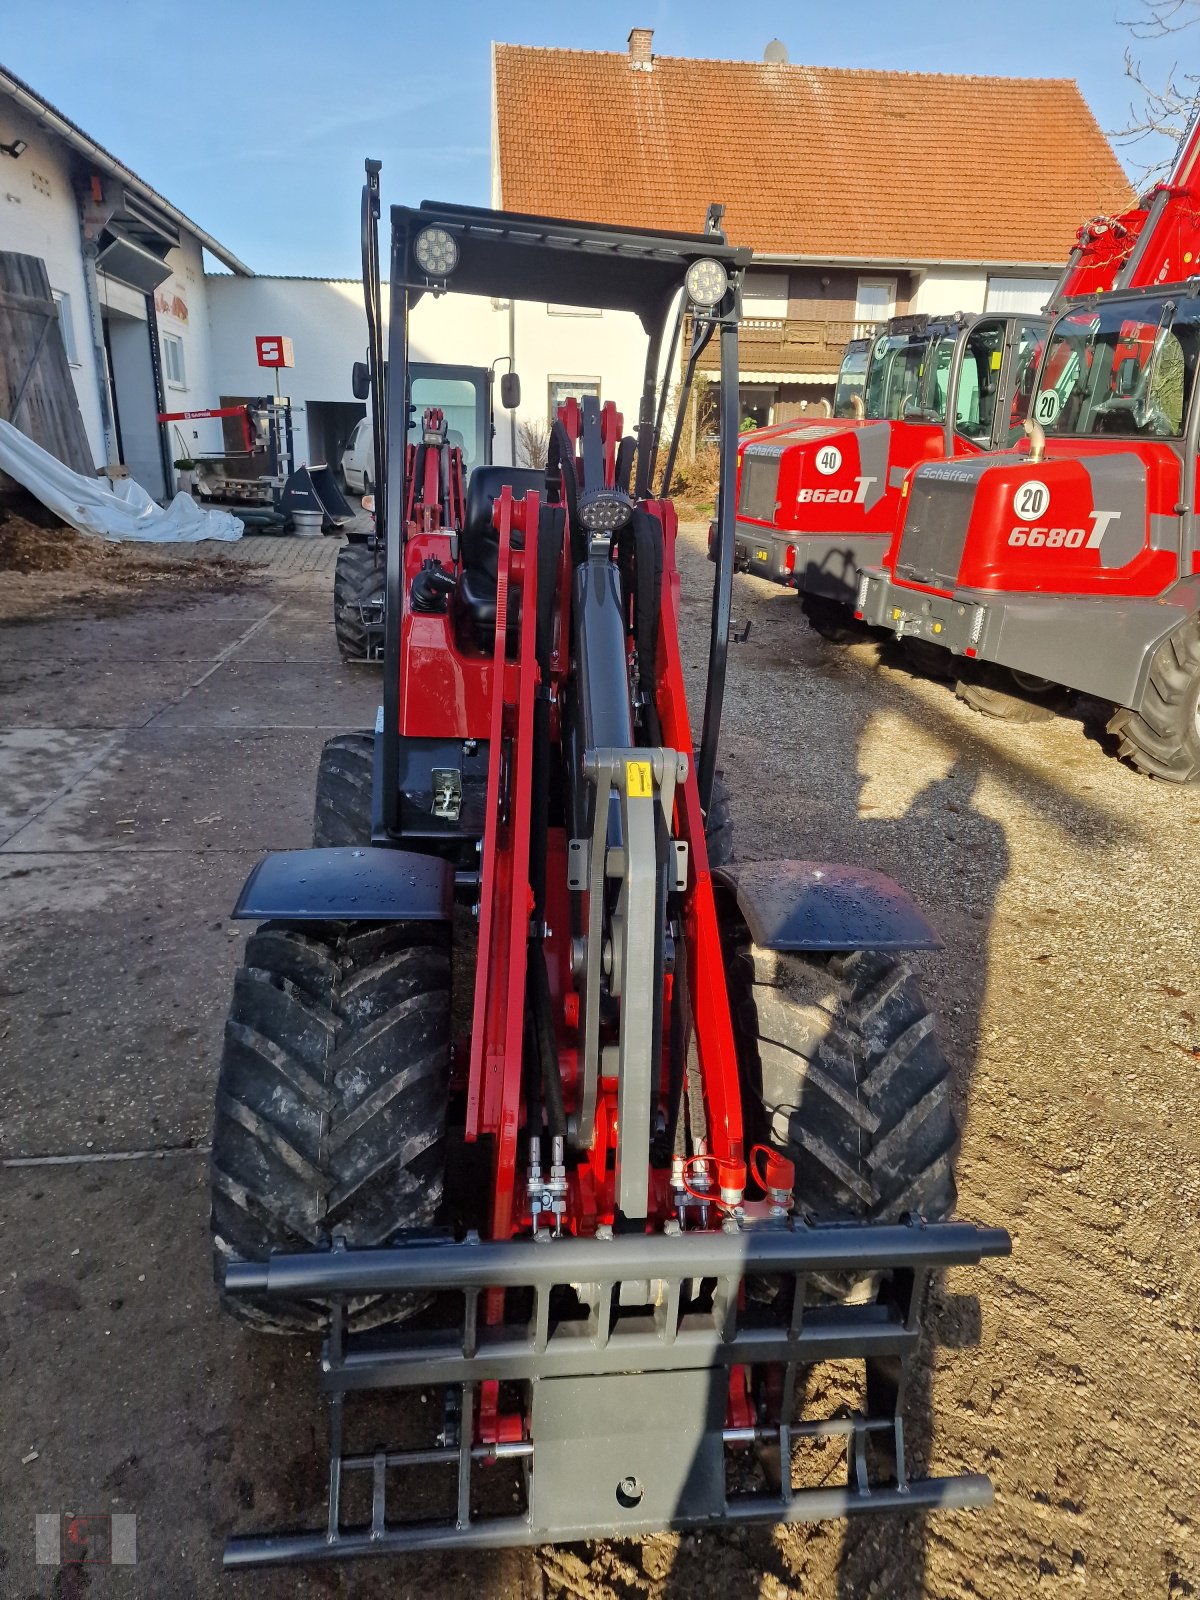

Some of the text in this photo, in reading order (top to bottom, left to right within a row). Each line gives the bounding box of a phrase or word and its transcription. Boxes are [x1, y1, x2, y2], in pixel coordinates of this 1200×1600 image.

[1039, 396, 1055, 418] 20
[821, 452, 837, 469] 40
[1020, 488, 1044, 513] 20
